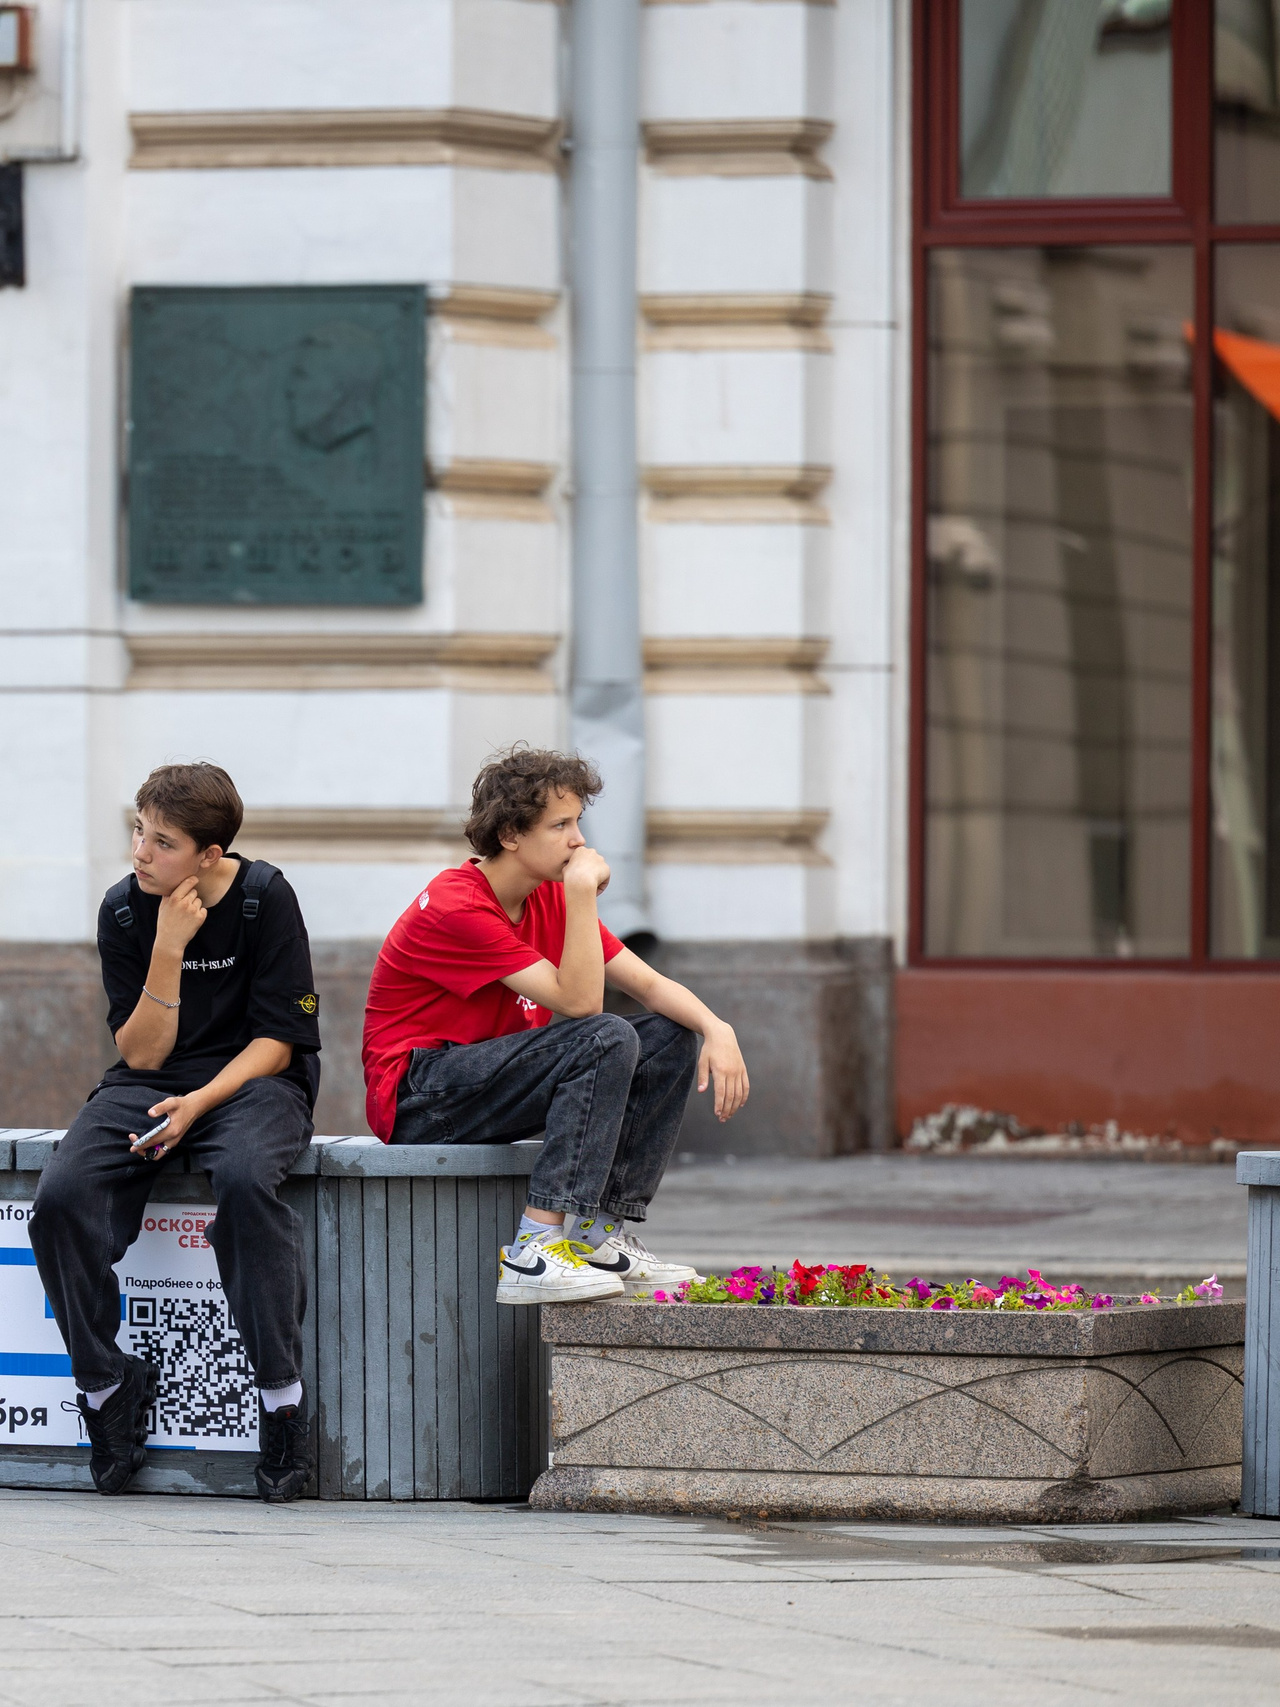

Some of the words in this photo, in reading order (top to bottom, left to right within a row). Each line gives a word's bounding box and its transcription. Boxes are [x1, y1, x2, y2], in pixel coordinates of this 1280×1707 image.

[140, 1218, 216, 1232] ОСКОВ
[126, 1277, 193, 1290] Подробнее
[195, 1281, 204, 1290] о
